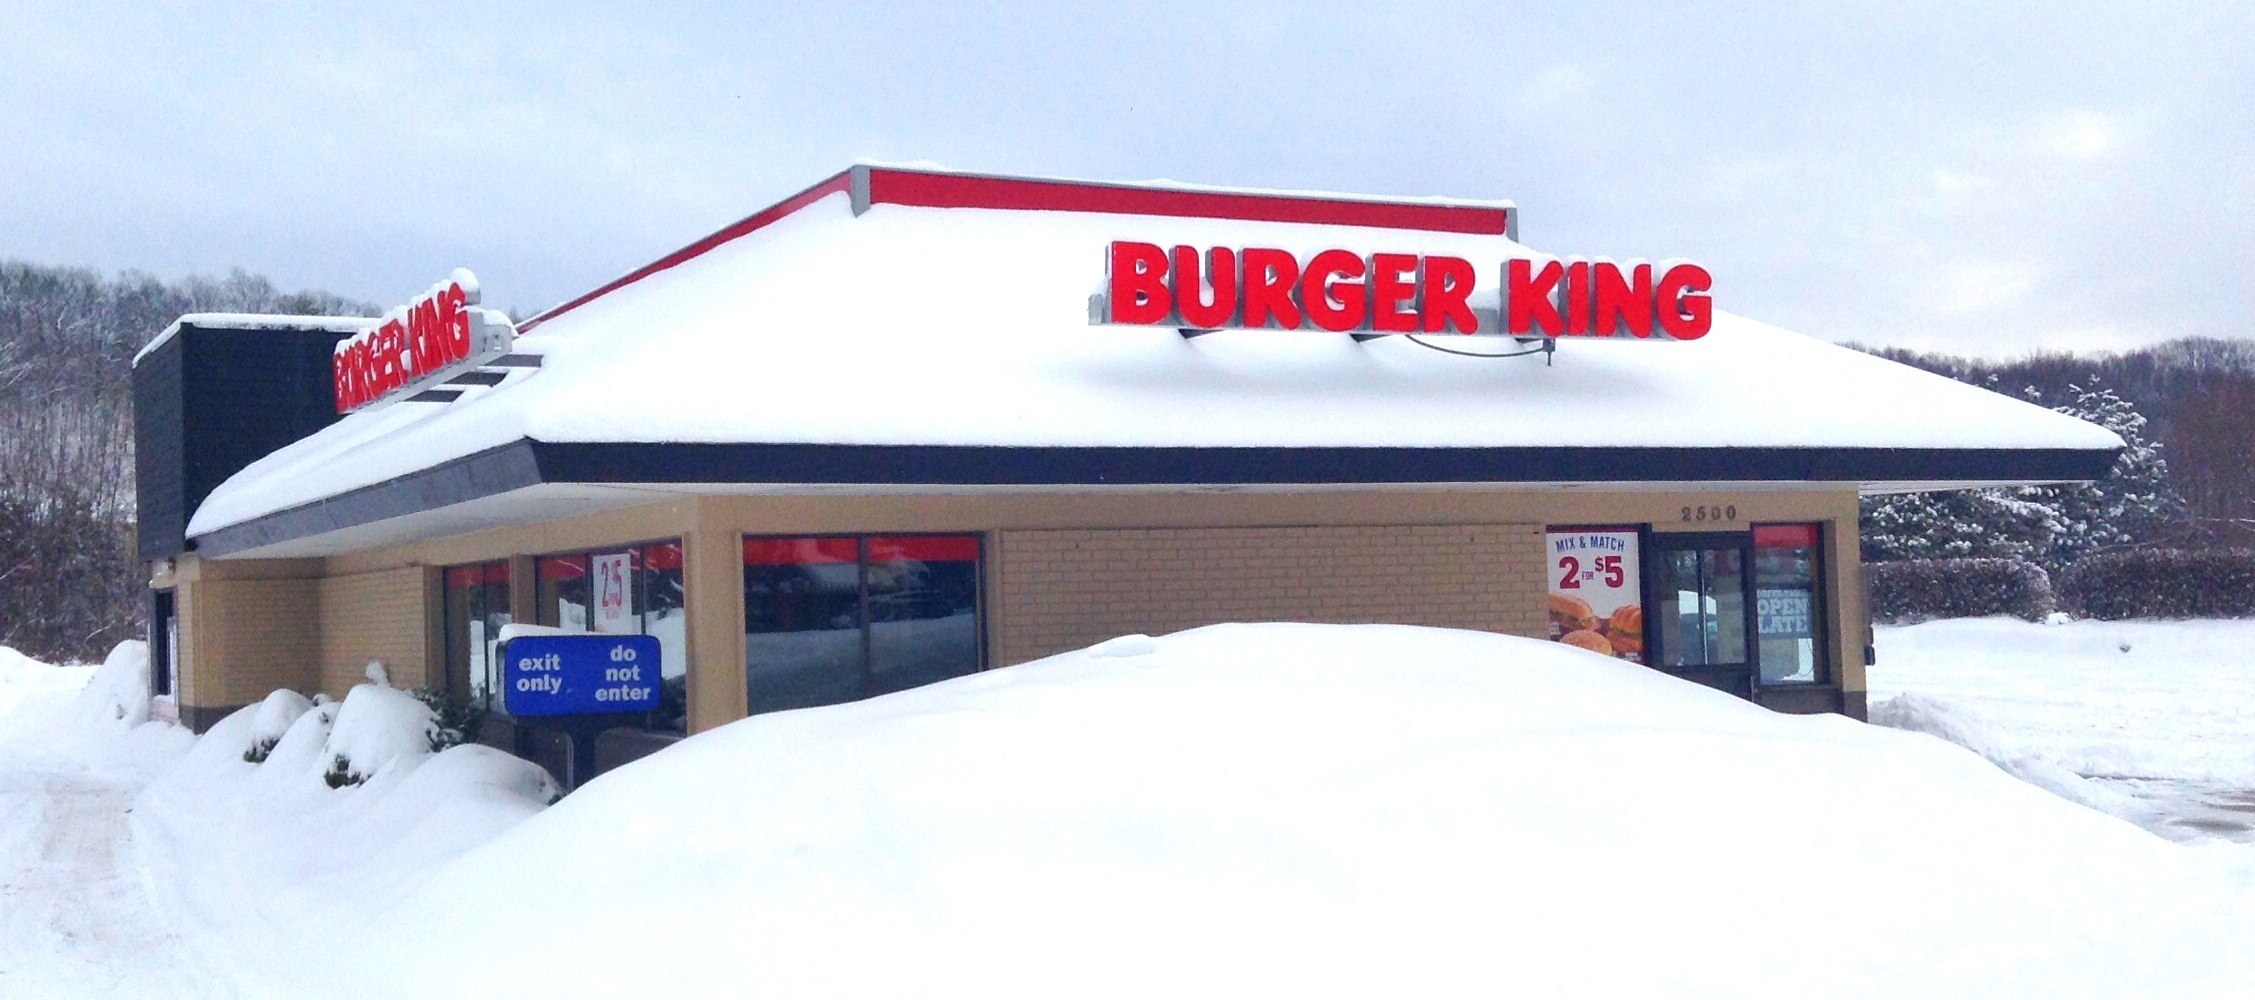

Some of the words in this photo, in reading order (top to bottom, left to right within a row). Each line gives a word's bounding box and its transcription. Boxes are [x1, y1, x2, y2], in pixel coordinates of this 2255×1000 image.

[1111, 240, 1478, 336] BURGER
[1508, 257, 1713, 341] KING
[333, 318, 409, 414] BURGER
[408, 282, 471, 378] KING
[1681, 505, 1737, 521] 2500
[1556, 537, 1576, 552] MIX
[1579, 536, 1586, 548] &
[1590, 535, 1625, 552] MATCH
[1559, 556, 1580, 589] 2
[1581, 571, 1595, 580] FOR
[1595, 555, 1624, 588] $5
[1757, 599, 1809, 615] OPEN
[1757, 615, 1809, 634] LATE
[610, 645, 636, 662] do
[518, 654, 561, 671] exit
[605, 664, 640, 682] not
[516, 674, 562, 694] only
[595, 686, 651, 702] enter
